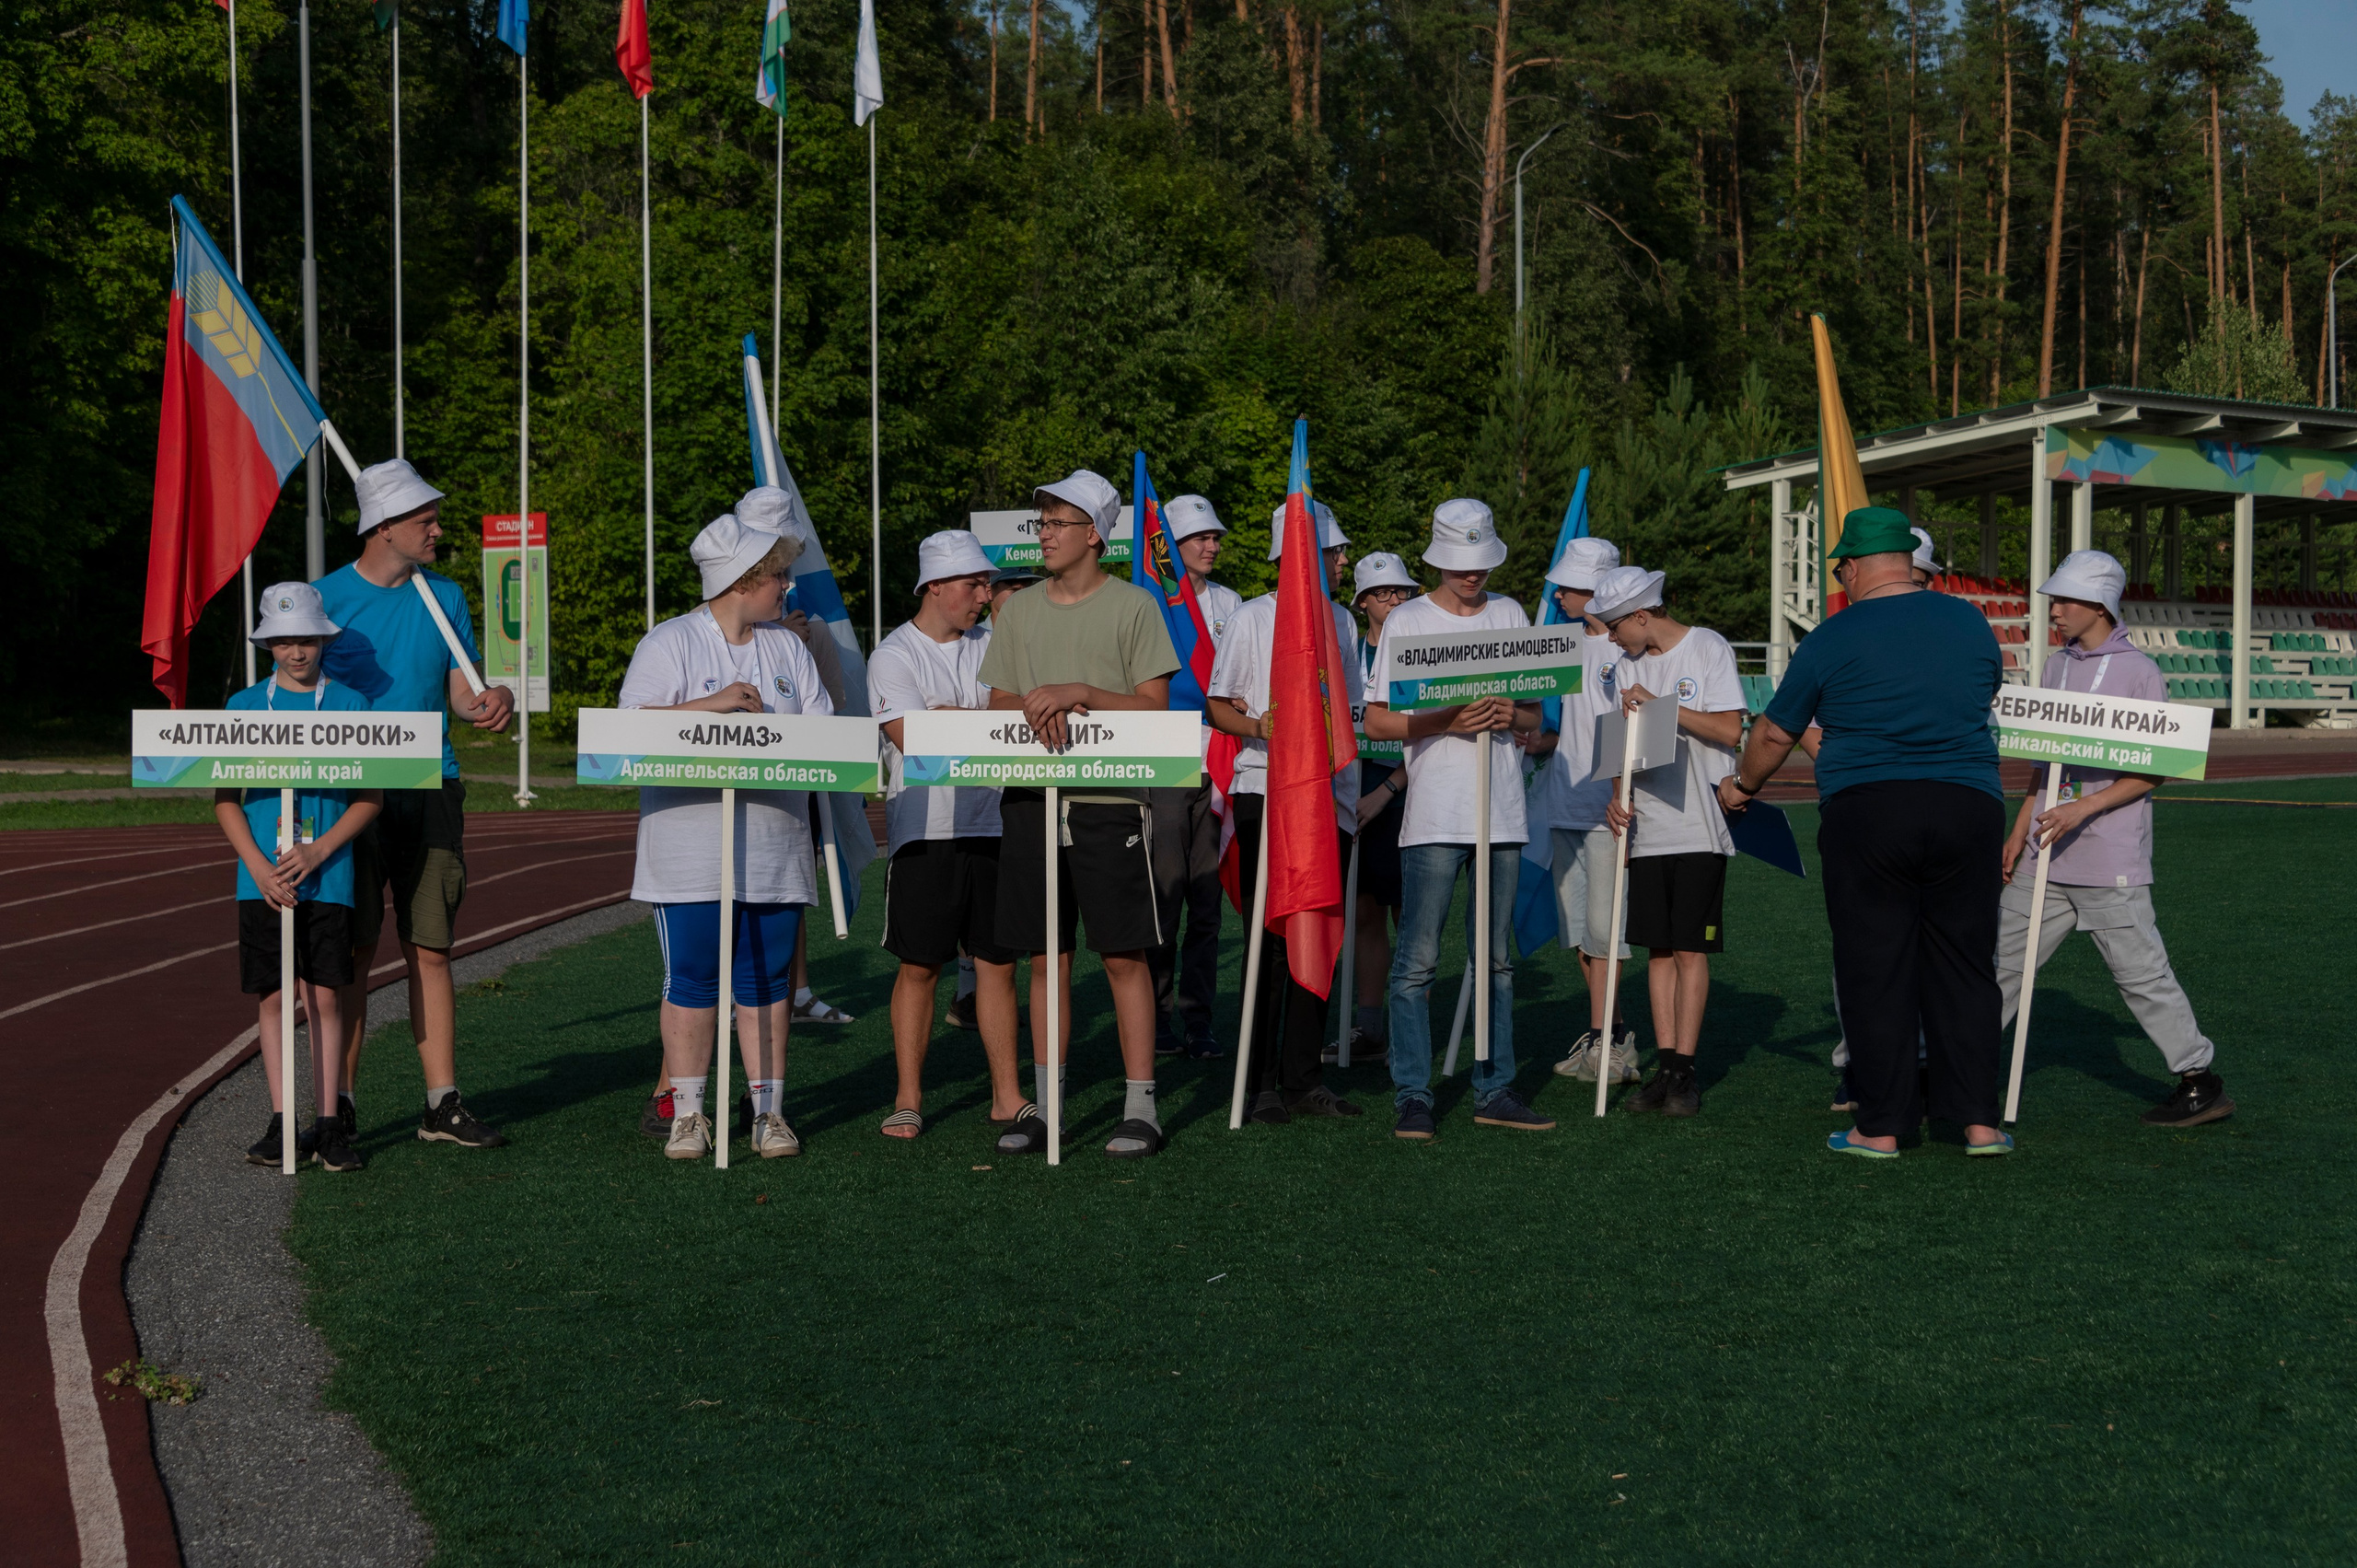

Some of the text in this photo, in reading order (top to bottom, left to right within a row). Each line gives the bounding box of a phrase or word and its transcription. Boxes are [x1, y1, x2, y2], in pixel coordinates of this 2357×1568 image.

[495, 520, 534, 532] СТАДИН
[1397, 636, 1576, 667] «ВЛАДИМИРСКИЕ САМОЦВЕТЫ»
[1418, 673, 1557, 702] Владимирская область
[158, 718, 416, 746] «АЛТАЙСКИЕ СОРОКИ»
[2110, 709, 2180, 735] КРАЙ»
[678, 724, 784, 747] «АЛМАЗ»
[2108, 748, 2153, 766] край
[211, 761, 363, 784] Алтайский край
[621, 759, 837, 783] Архангельская область
[949, 760, 1155, 782] Белгородская область
